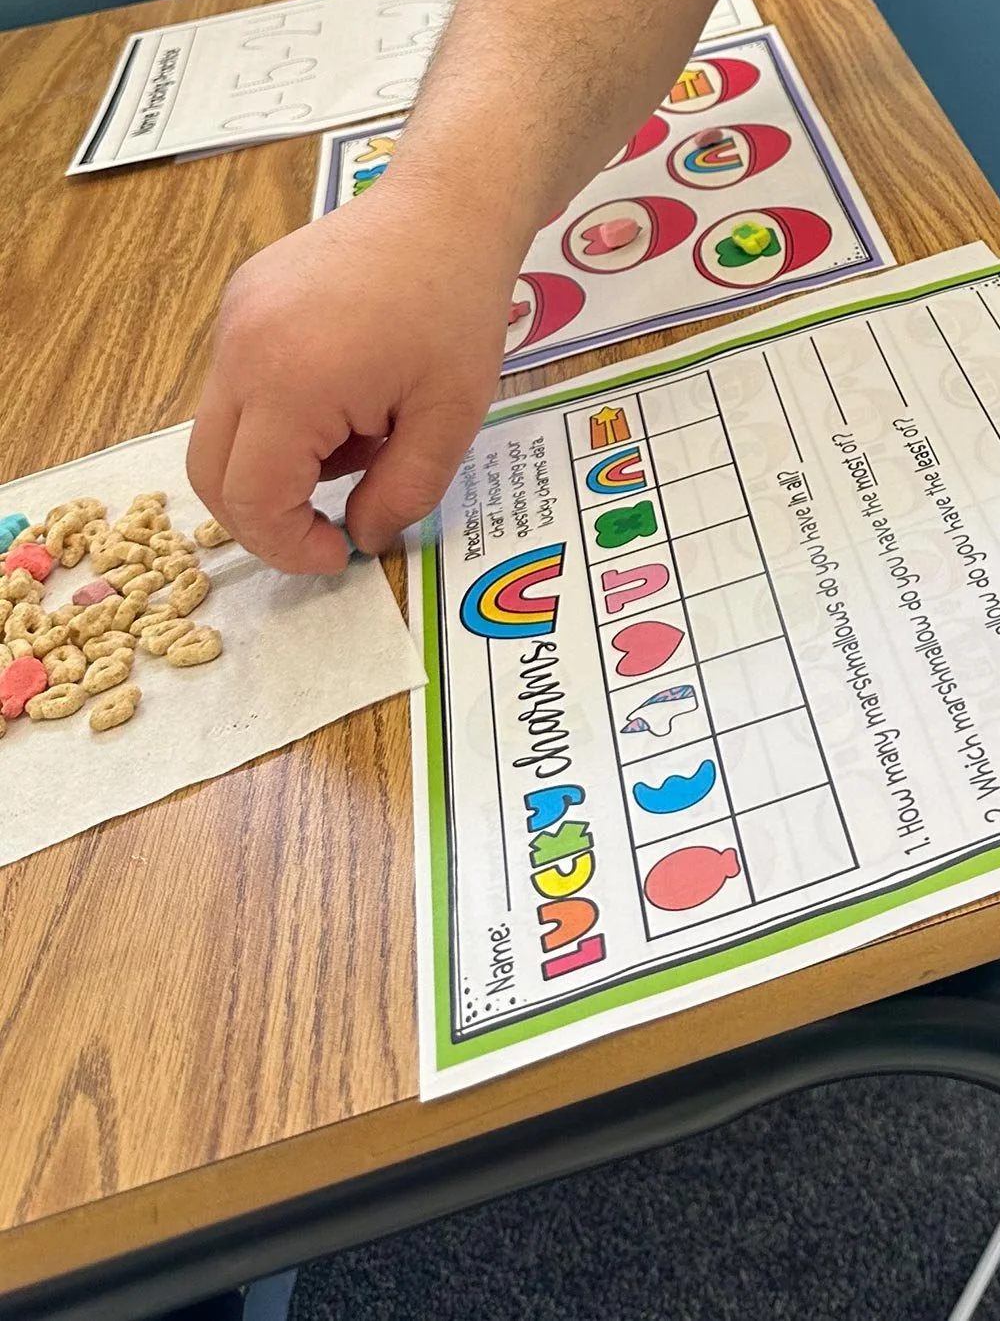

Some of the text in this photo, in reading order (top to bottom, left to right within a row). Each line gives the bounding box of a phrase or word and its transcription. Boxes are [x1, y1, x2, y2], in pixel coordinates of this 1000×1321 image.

[831, 433, 857, 453] of?
[892, 417, 919, 439] of?
[842, 455, 876, 492] most
[902, 438, 937, 473] least
[484, 451, 505, 538] chart. Answer the
[508, 441, 533, 538] questions using your
[529, 435, 558, 529] lucky charms data.
[924, 471, 947, 497] the
[861, 492, 884, 518] the
[936, 496, 964, 534] have
[463, 507, 482, 561] Directions:
[871, 517, 900, 557] have
[952, 534, 987, 567] you
[886, 556, 921, 589] you
[966, 567, 990, 589] do
[898, 590, 922, 611] do
[776, 470, 931, 856] 1. How many marshmallows do you have in all?
[910, 615, 975, 734] marshmallow
[957, 733, 1000, 801] Which
[512, 640, 608, 982] LUCKY charms
[485, 922, 515, 996] Name:
